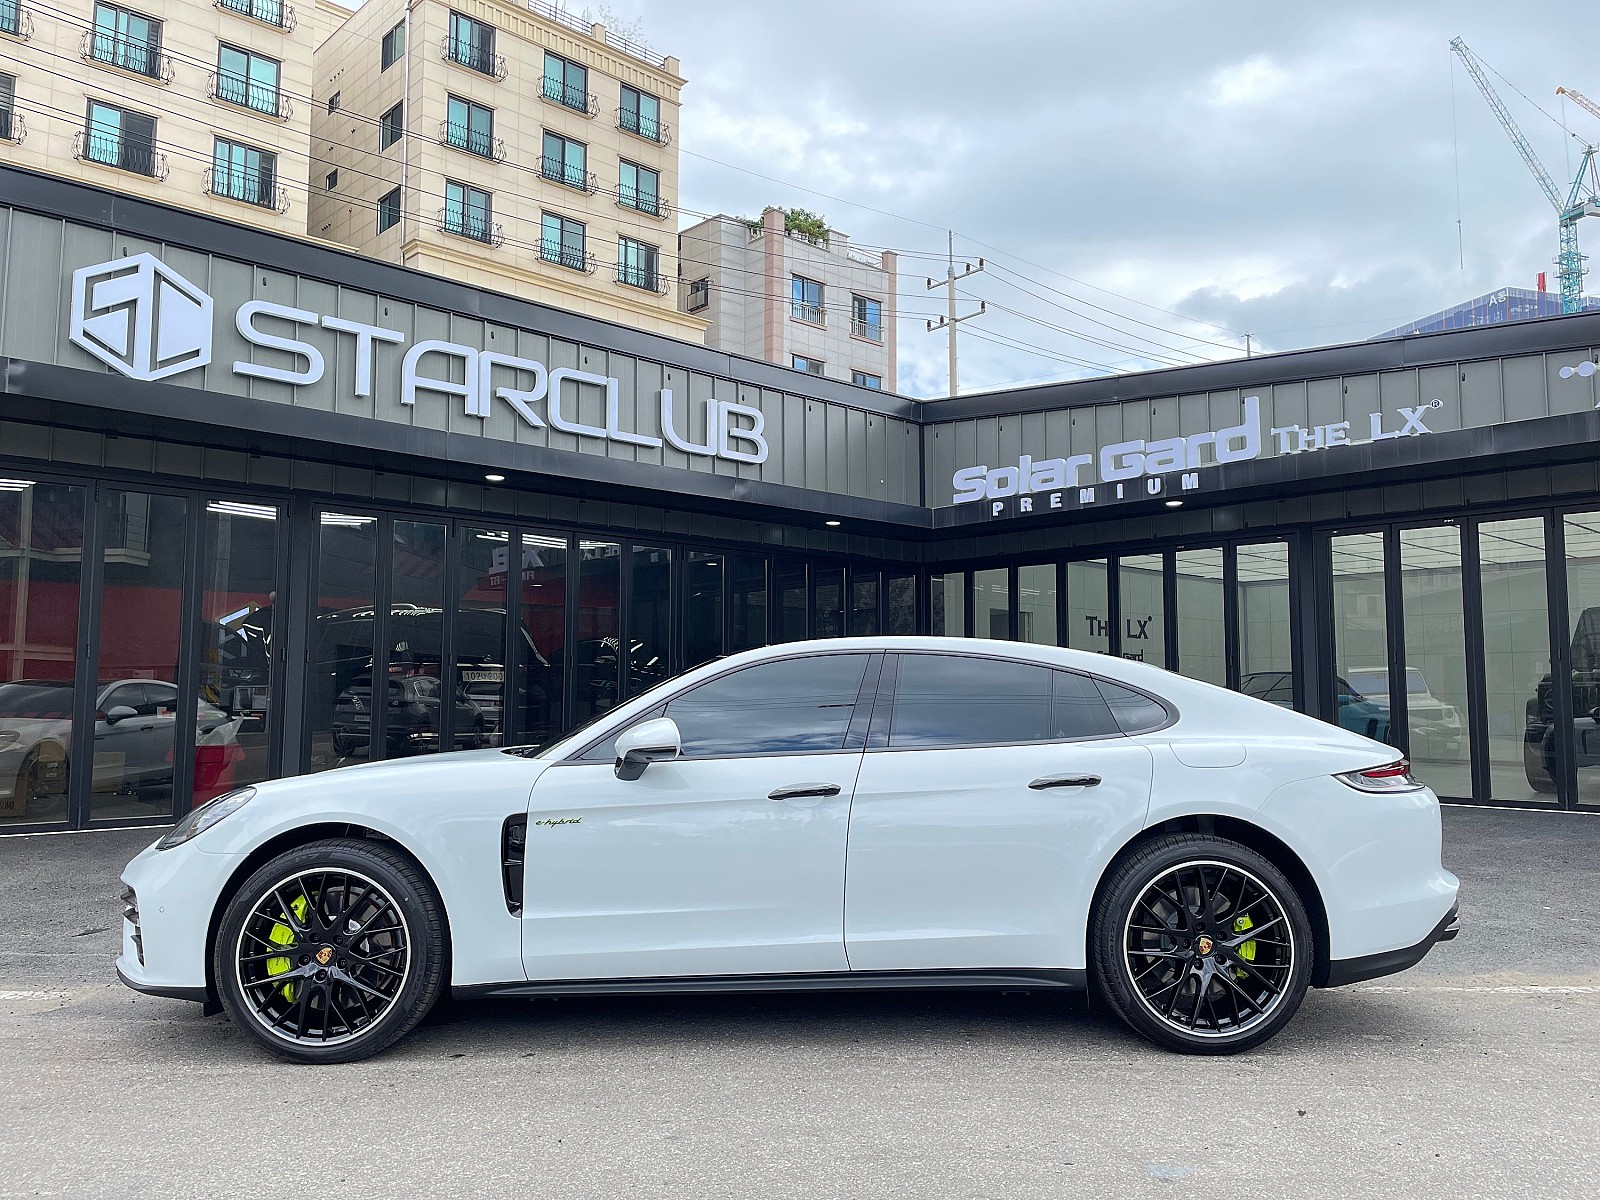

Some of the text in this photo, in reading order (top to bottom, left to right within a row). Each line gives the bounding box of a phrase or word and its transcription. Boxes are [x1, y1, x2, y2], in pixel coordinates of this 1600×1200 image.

[232, 299, 770, 465] STARCLUB
[952, 454, 1093, 504] Solar
[1099, 396, 1262, 483] Gard
[1270, 420, 1350, 455] THE
[991, 472, 1200, 517] PREMIUM
[1085, 614, 1109, 637] TH
[535, 816, 583, 829] e-hybrid
